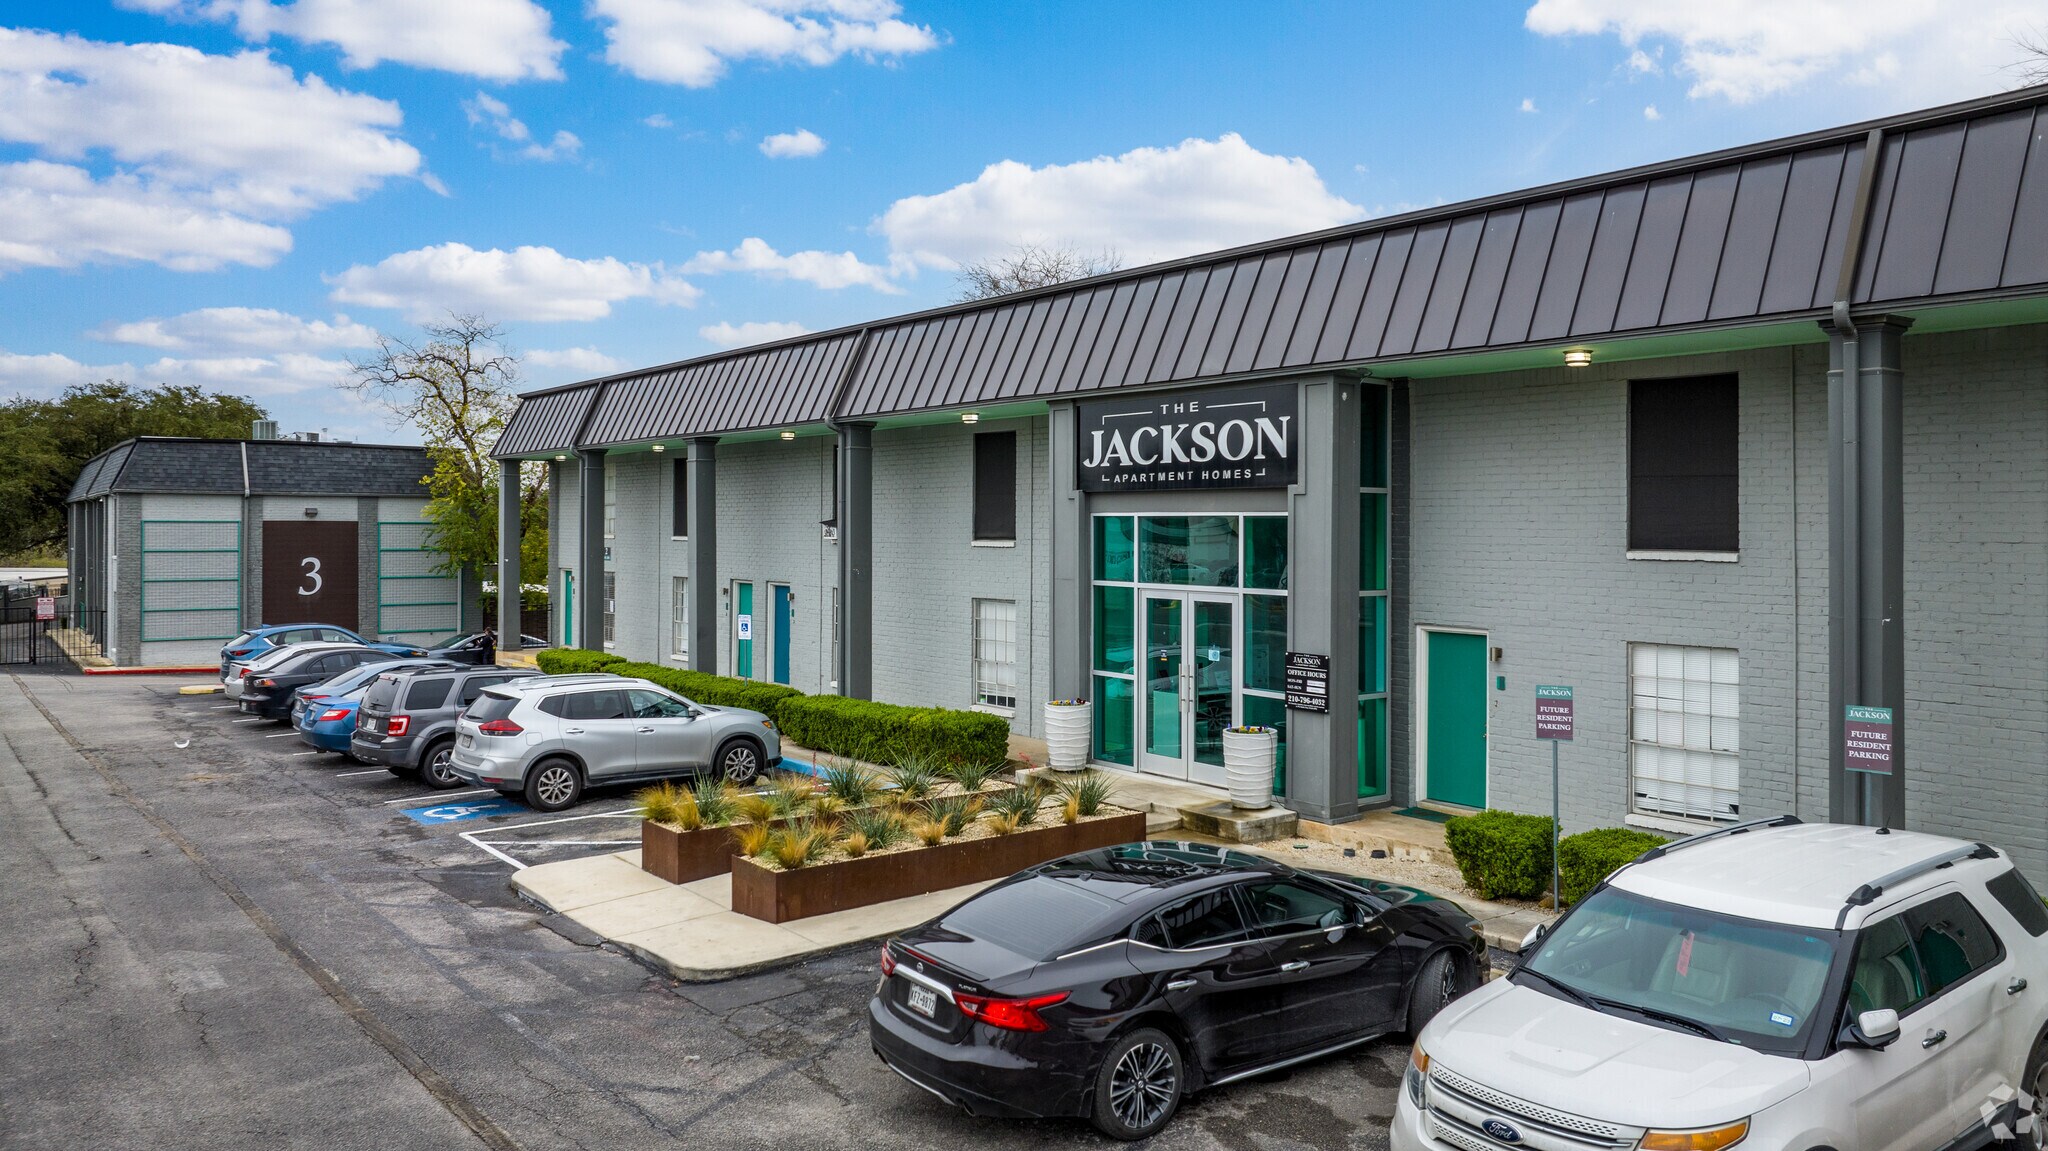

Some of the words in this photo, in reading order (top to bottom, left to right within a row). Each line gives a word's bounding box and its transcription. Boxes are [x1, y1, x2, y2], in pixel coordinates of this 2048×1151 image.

[1160, 401, 1199, 415] THE
[1083, 415, 1291, 468] JACKSON
[1113, 470, 1194, 483] APARTMENT
[1201, 468, 1252, 480] HOMES
[298, 557, 322, 595] 3
[1293, 657, 1320, 665] JACKSON
[1848, 710, 1890, 720] JACKSON
[1851, 730, 1887, 740] FUTURE
[1847, 740, 1892, 750] RESIDENT
[1848, 750, 1889, 760] PARKING
[1489, 1122, 1512, 1139] Ford
